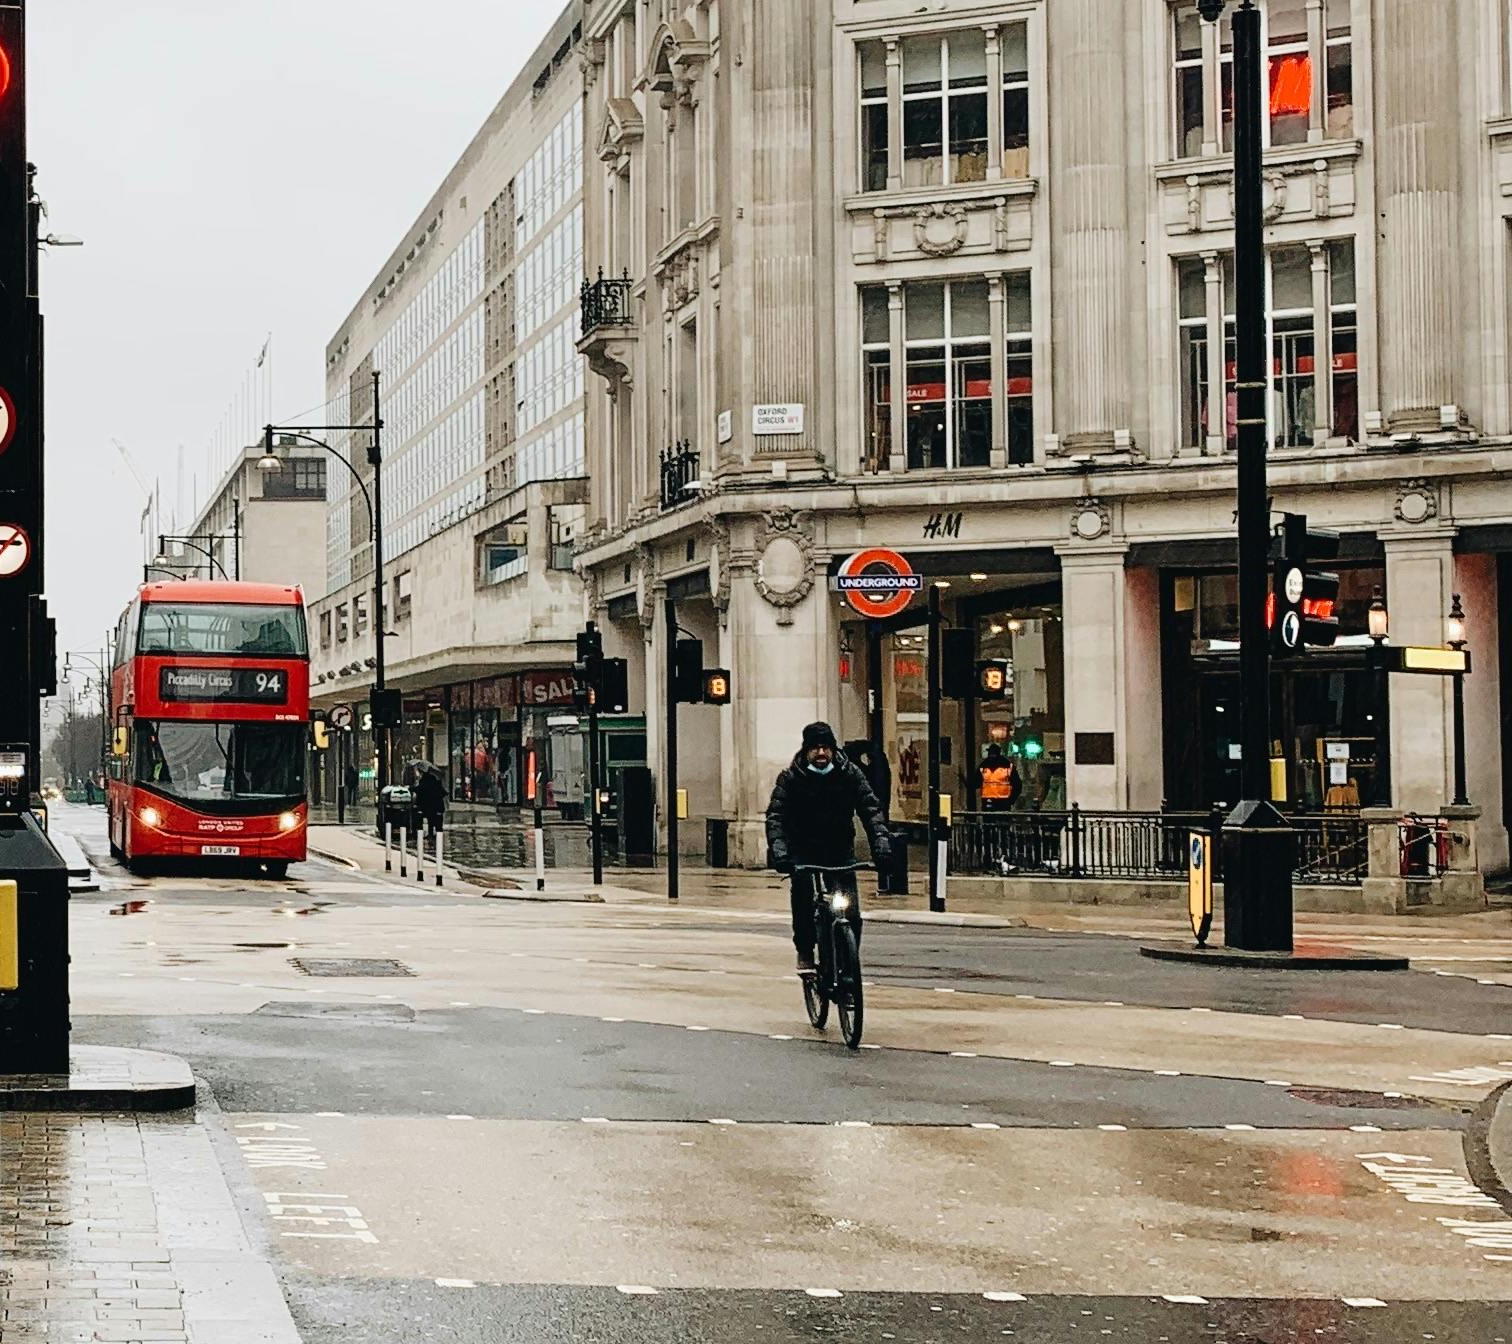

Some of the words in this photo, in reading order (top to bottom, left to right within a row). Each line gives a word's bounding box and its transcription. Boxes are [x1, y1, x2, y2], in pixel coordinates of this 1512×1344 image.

[906, 388, 928, 398] SALE
[922, 512, 963, 539] H&M
[839, 577, 919, 588] UNDERGROUND
[167, 672, 206, 689] Piccadilly
[208, 673, 232, 687] Circus
[255, 672, 280, 693] 94
[262, 1192, 380, 1244] LEFT
